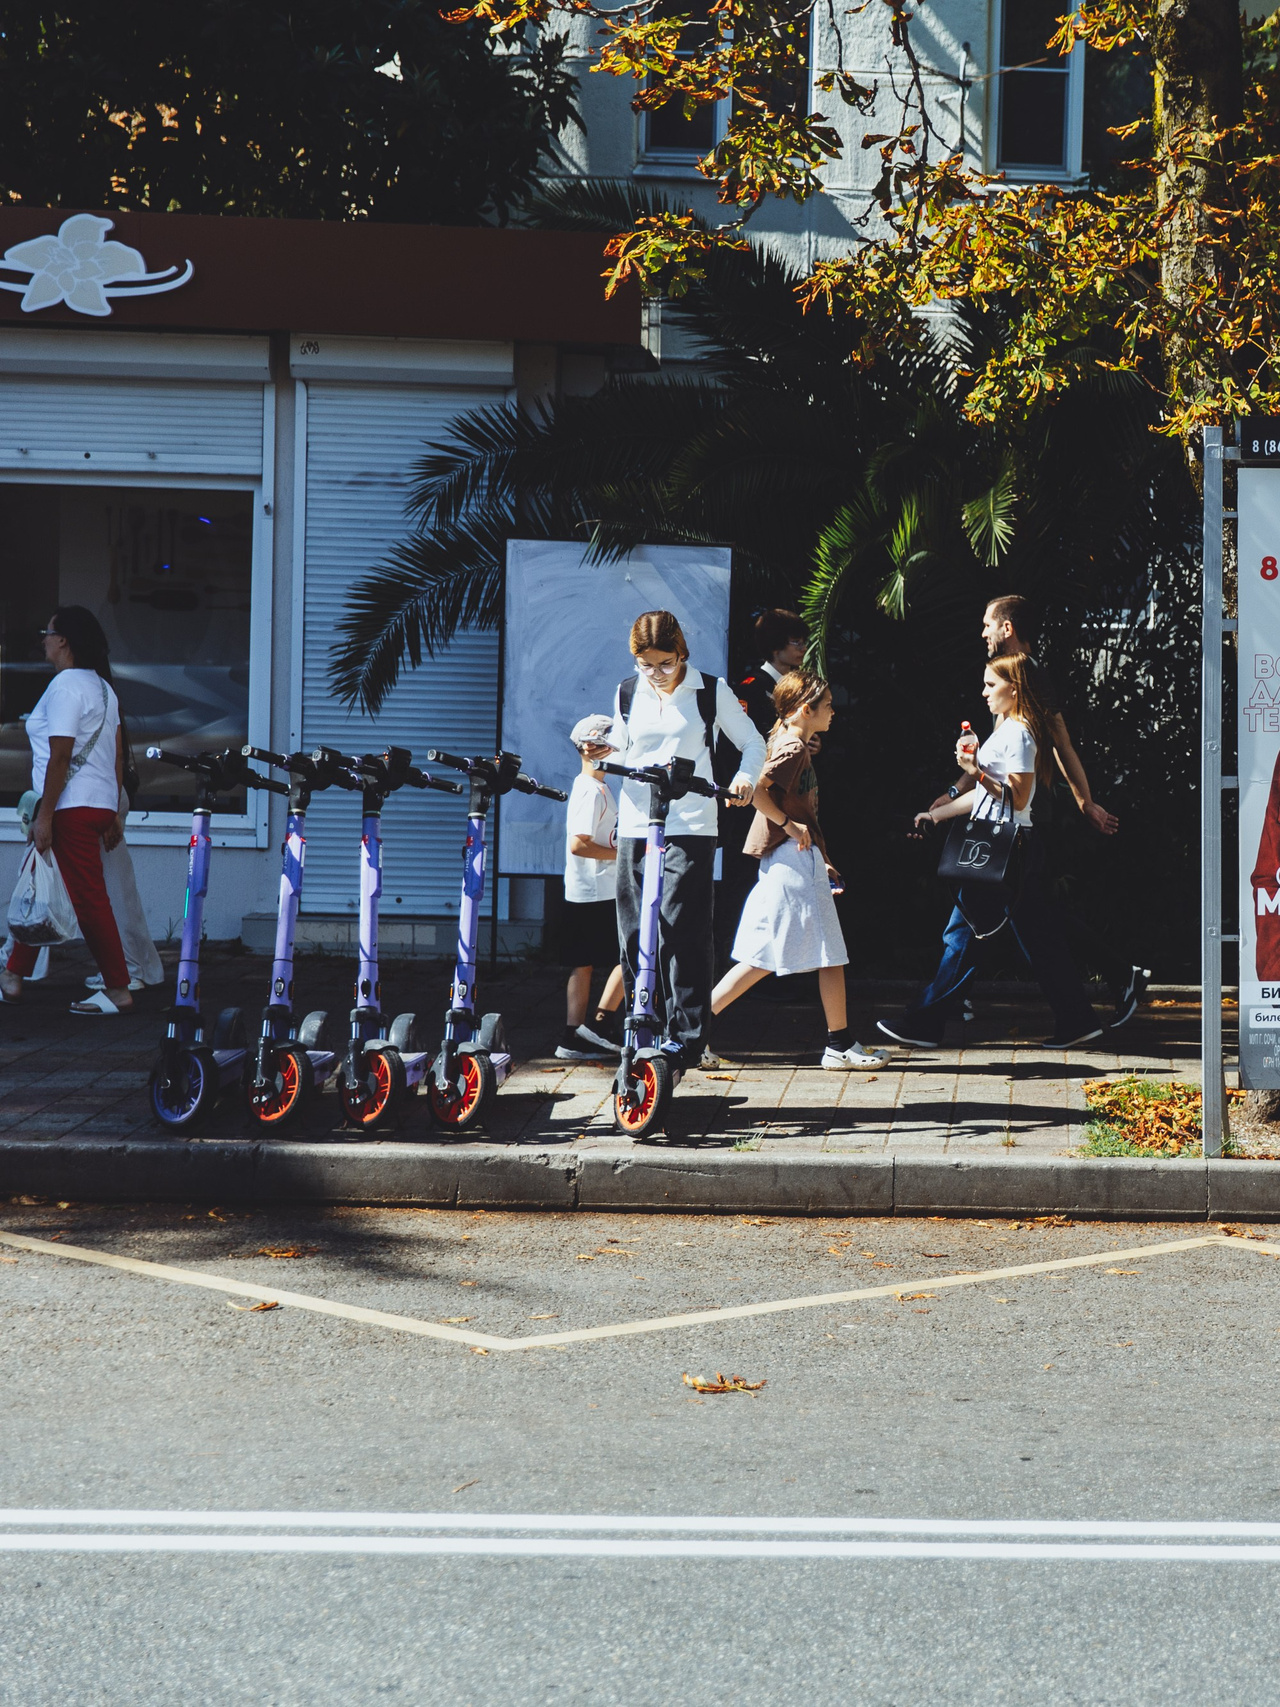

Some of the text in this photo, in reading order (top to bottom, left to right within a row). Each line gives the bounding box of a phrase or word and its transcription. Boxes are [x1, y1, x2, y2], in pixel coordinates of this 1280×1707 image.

[1252, 440, 1261, 454] 8
[1259, 555, 1280, 581] 8
[956, 838, 992, 870] DG
